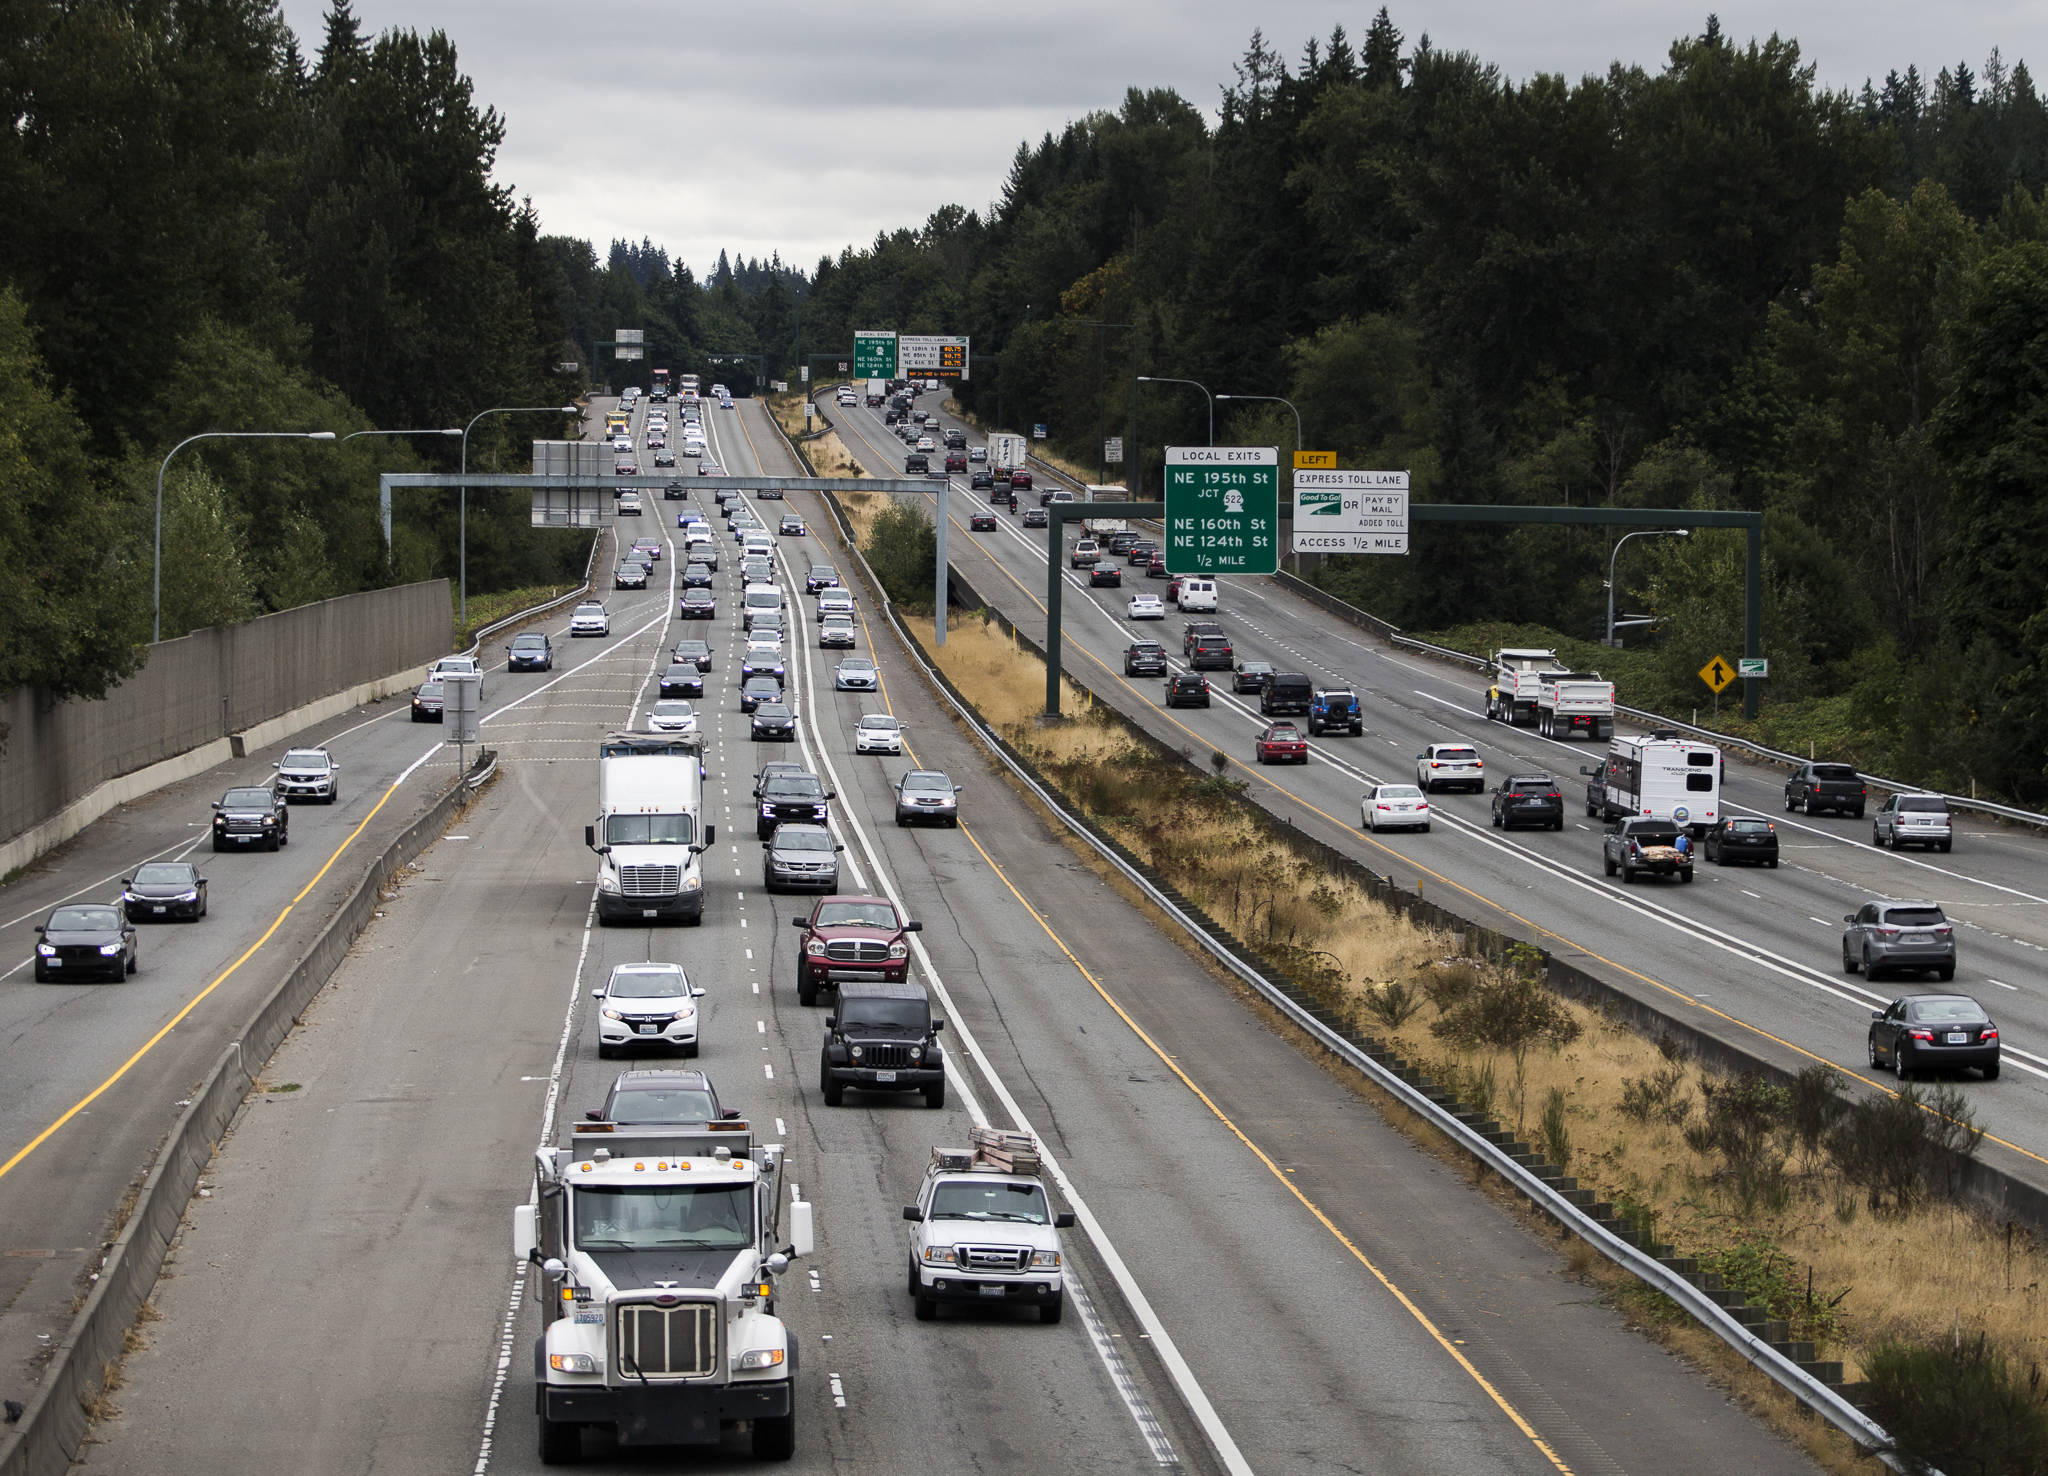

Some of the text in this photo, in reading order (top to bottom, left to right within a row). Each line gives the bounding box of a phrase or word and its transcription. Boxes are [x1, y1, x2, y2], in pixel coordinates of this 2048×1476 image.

[1182, 452, 1261, 460] LOCAL EXITS
[1302, 456, 1328, 464] LEFT
[1175, 472, 1268, 484] NE 195th St
[1299, 474, 1401, 484] EXPRESS TOLL LANE
[1198, 489, 1242, 504] JCT 522
[1344, 500, 1358, 509] OR
[1174, 519, 1266, 530] NE 160th St
[1174, 536, 1268, 547] NE 124th St
[1299, 538, 1346, 547] ACCESS
[1375, 539, 1401, 548] MILE
[1219, 556, 1245, 565] MILE
